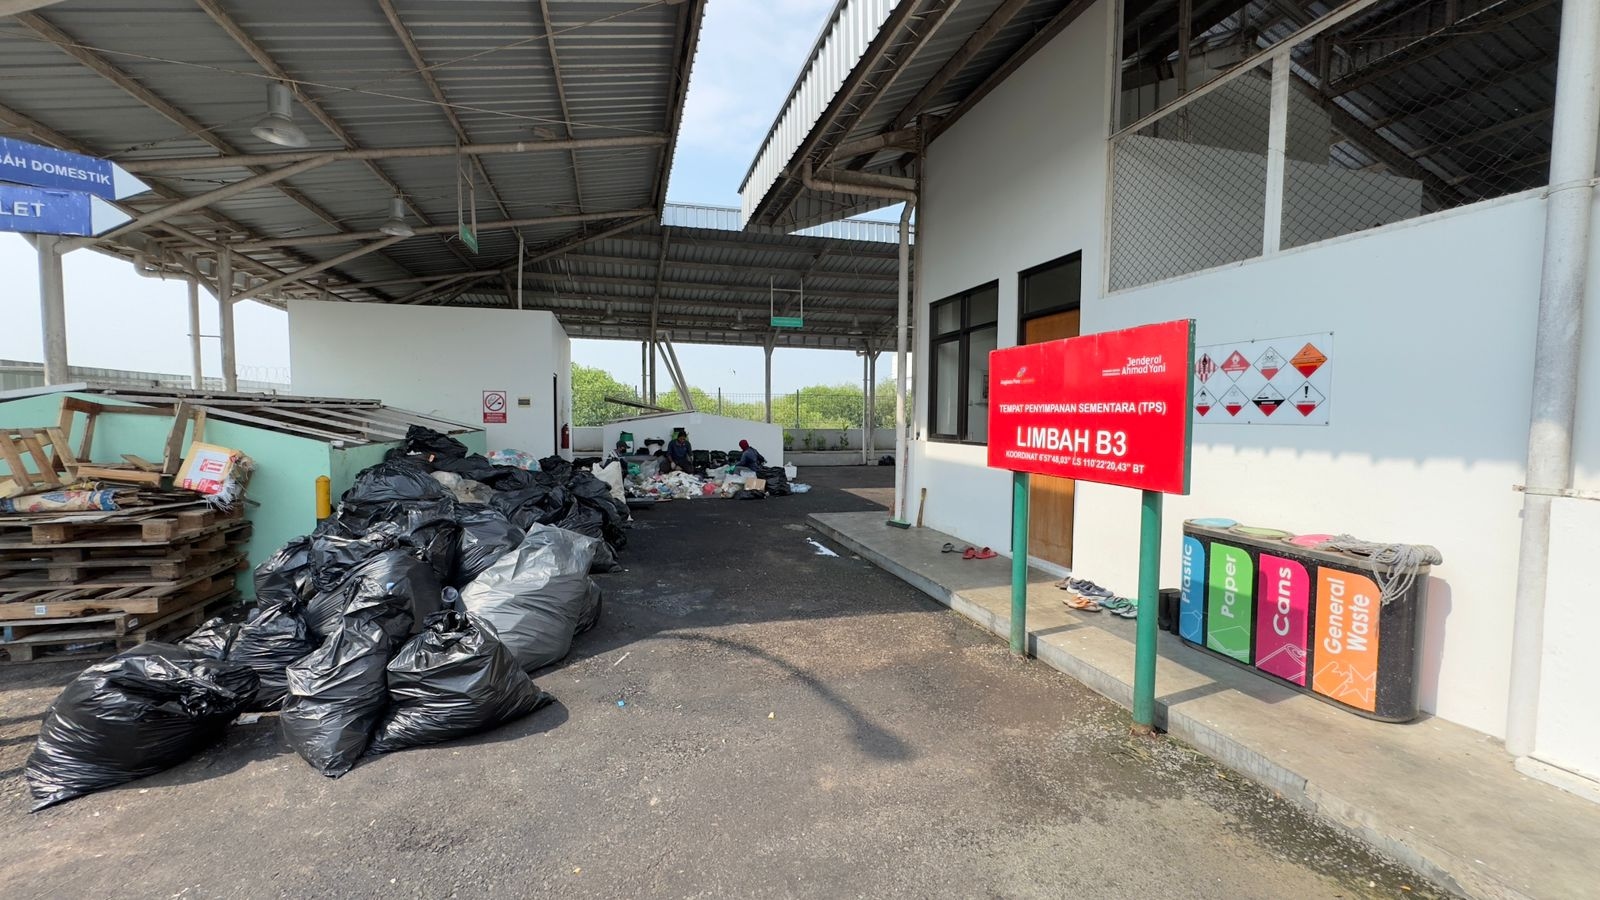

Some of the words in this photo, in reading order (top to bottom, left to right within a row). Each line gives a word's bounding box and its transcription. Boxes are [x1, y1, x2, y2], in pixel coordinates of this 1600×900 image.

[0, 153, 27, 168] AH
[31, 160, 111, 185] DOMESTIK
[0, 200, 45, 217] LET
[1121, 363, 1148, 375] Ahmad
[1149, 362, 1166, 373] Yani
[1127, 354, 1162, 367] Jenderal
[999, 403, 1024, 413] TEMPAT
[1025, 403, 1077, 413] PENYIMPANAN
[1078, 402, 1136, 413] SEMENTARA
[1138, 401, 1166, 415] (TPS)
[1017, 426, 1089, 453] LIMBAH
[1095, 430, 1127, 456] B3
[1005, 450, 1038, 460] KOORDINAT
[1072, 456, 1081, 466] LS
[1132, 464, 1145, 474] BT
[1181, 543, 1193, 603] Plastic
[1221, 553, 1237, 618] Paper
[1273, 567, 1292, 636] Cans
[1324, 577, 1345, 655] General
[1346, 594, 1370, 652] Waste
